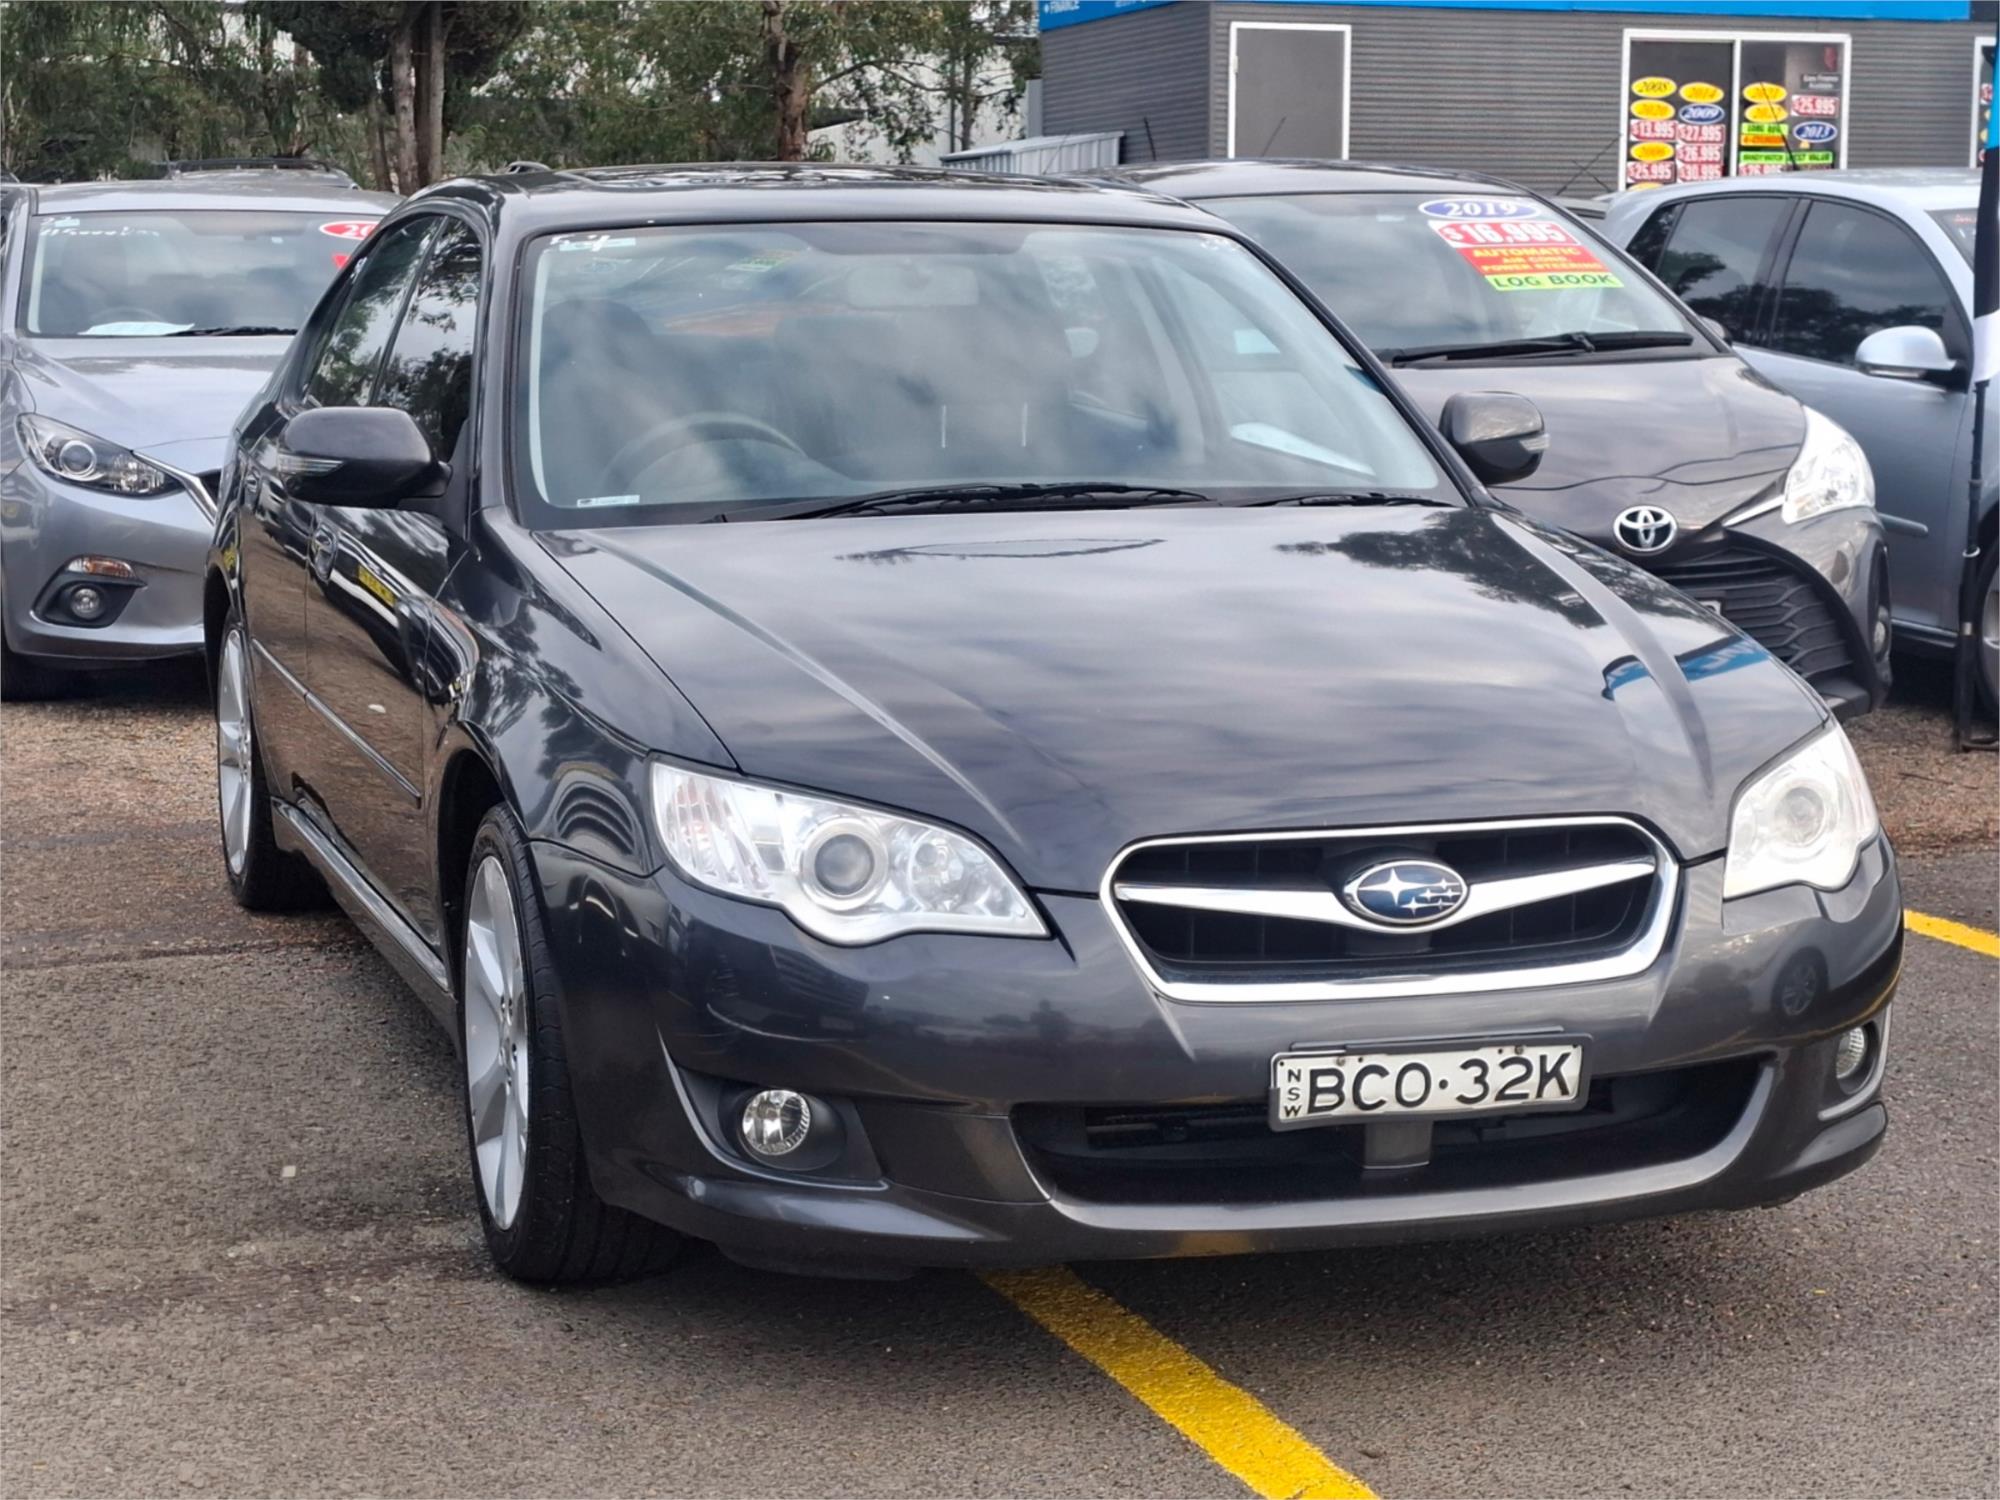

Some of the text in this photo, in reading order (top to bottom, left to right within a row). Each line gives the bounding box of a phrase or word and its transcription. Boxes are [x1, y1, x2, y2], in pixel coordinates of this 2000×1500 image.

[1680, 125, 1722, 142] $27,995
[1445, 202, 1518, 217] 2019
[1442, 223, 1567, 244] $16,995
[1473, 247, 1581, 257] AUTOMATIC
[1495, 274, 1613, 288] LOG BOOK
